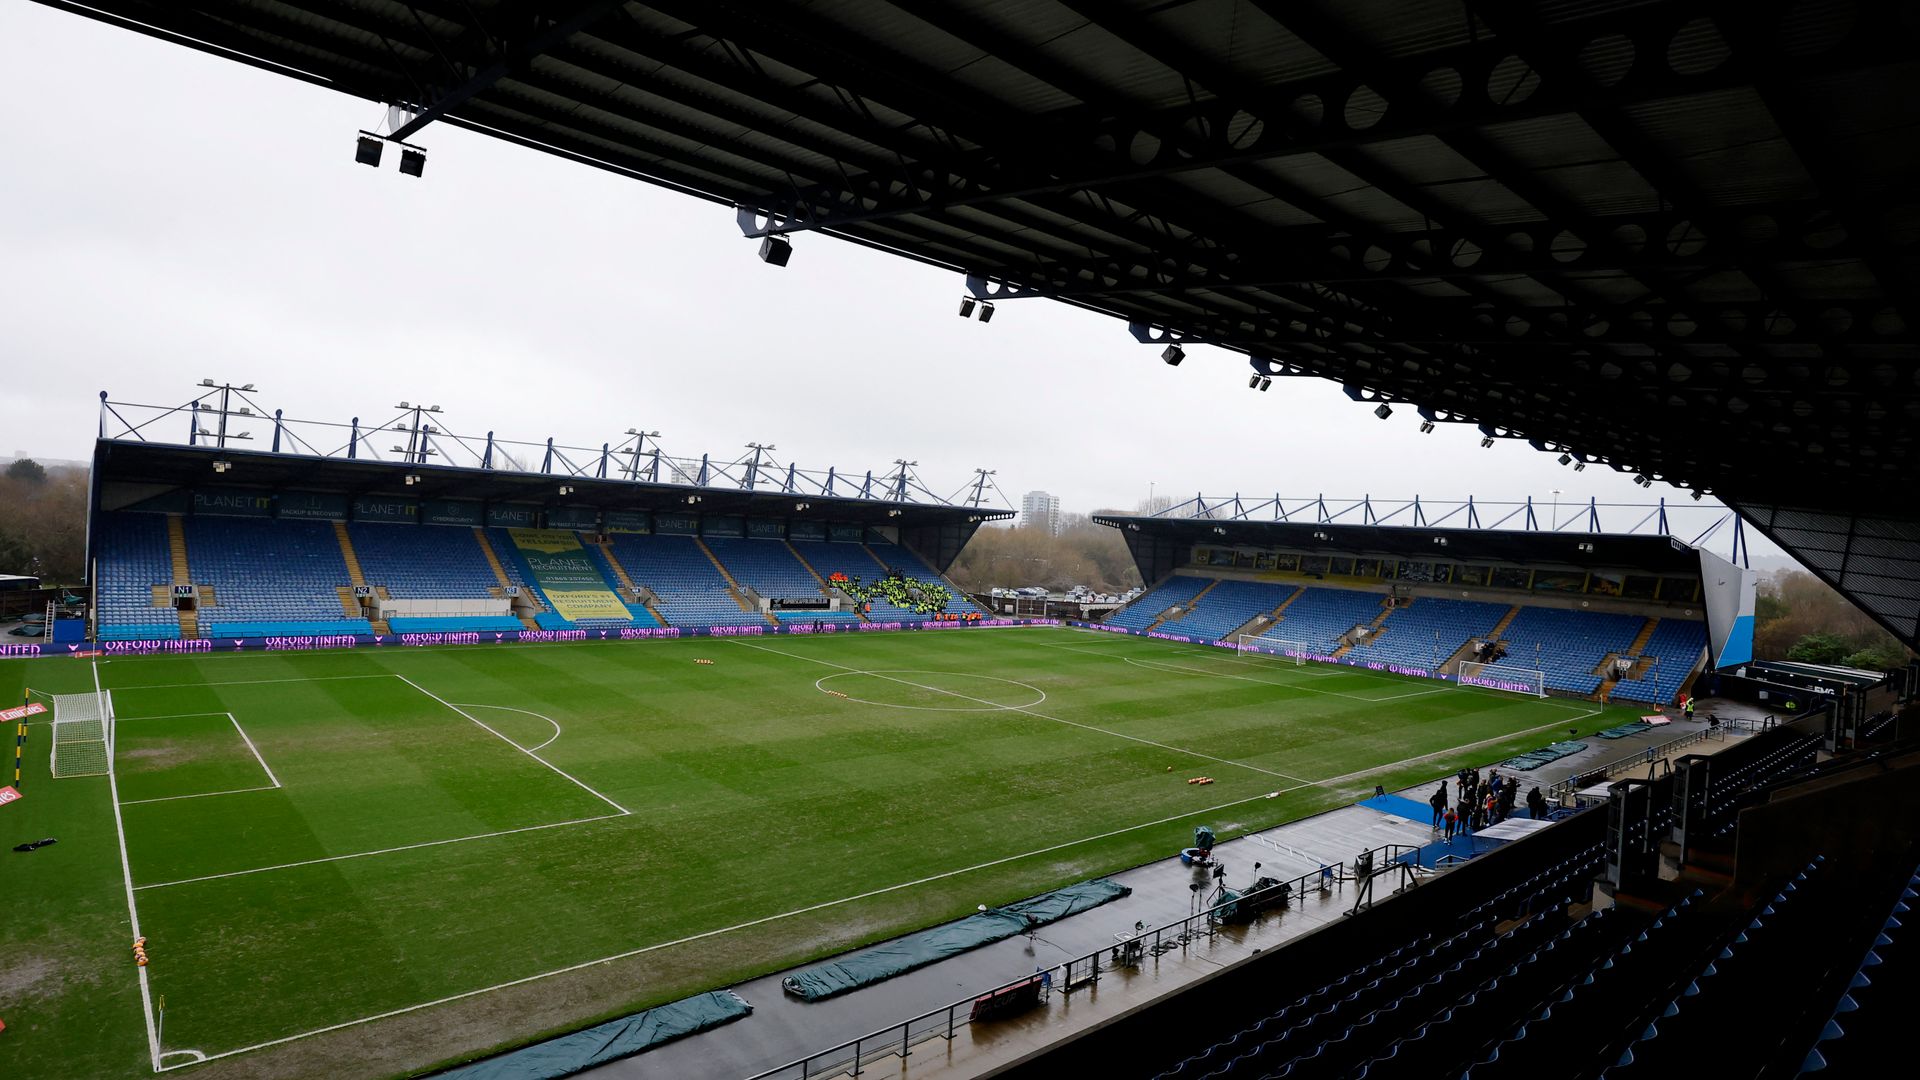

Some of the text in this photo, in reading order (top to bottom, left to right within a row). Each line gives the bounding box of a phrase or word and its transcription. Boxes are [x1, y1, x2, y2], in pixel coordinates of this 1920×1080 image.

[194, 494, 271, 509] PLANET IT
[405, 505, 417, 515] IT
[527, 558, 589, 566] PLANET
[178, 586, 189, 594] N1
[556, 630, 586, 639] UNITED
[653, 627, 679, 635] UNITED
[265, 635, 355, 645] OXFORD UNITED
[402, 632, 479, 641] OXFORD UNITED
[105, 638, 211, 650] OXFORD UNITED
[1461, 676, 1530, 692] OXFORD UNITED
